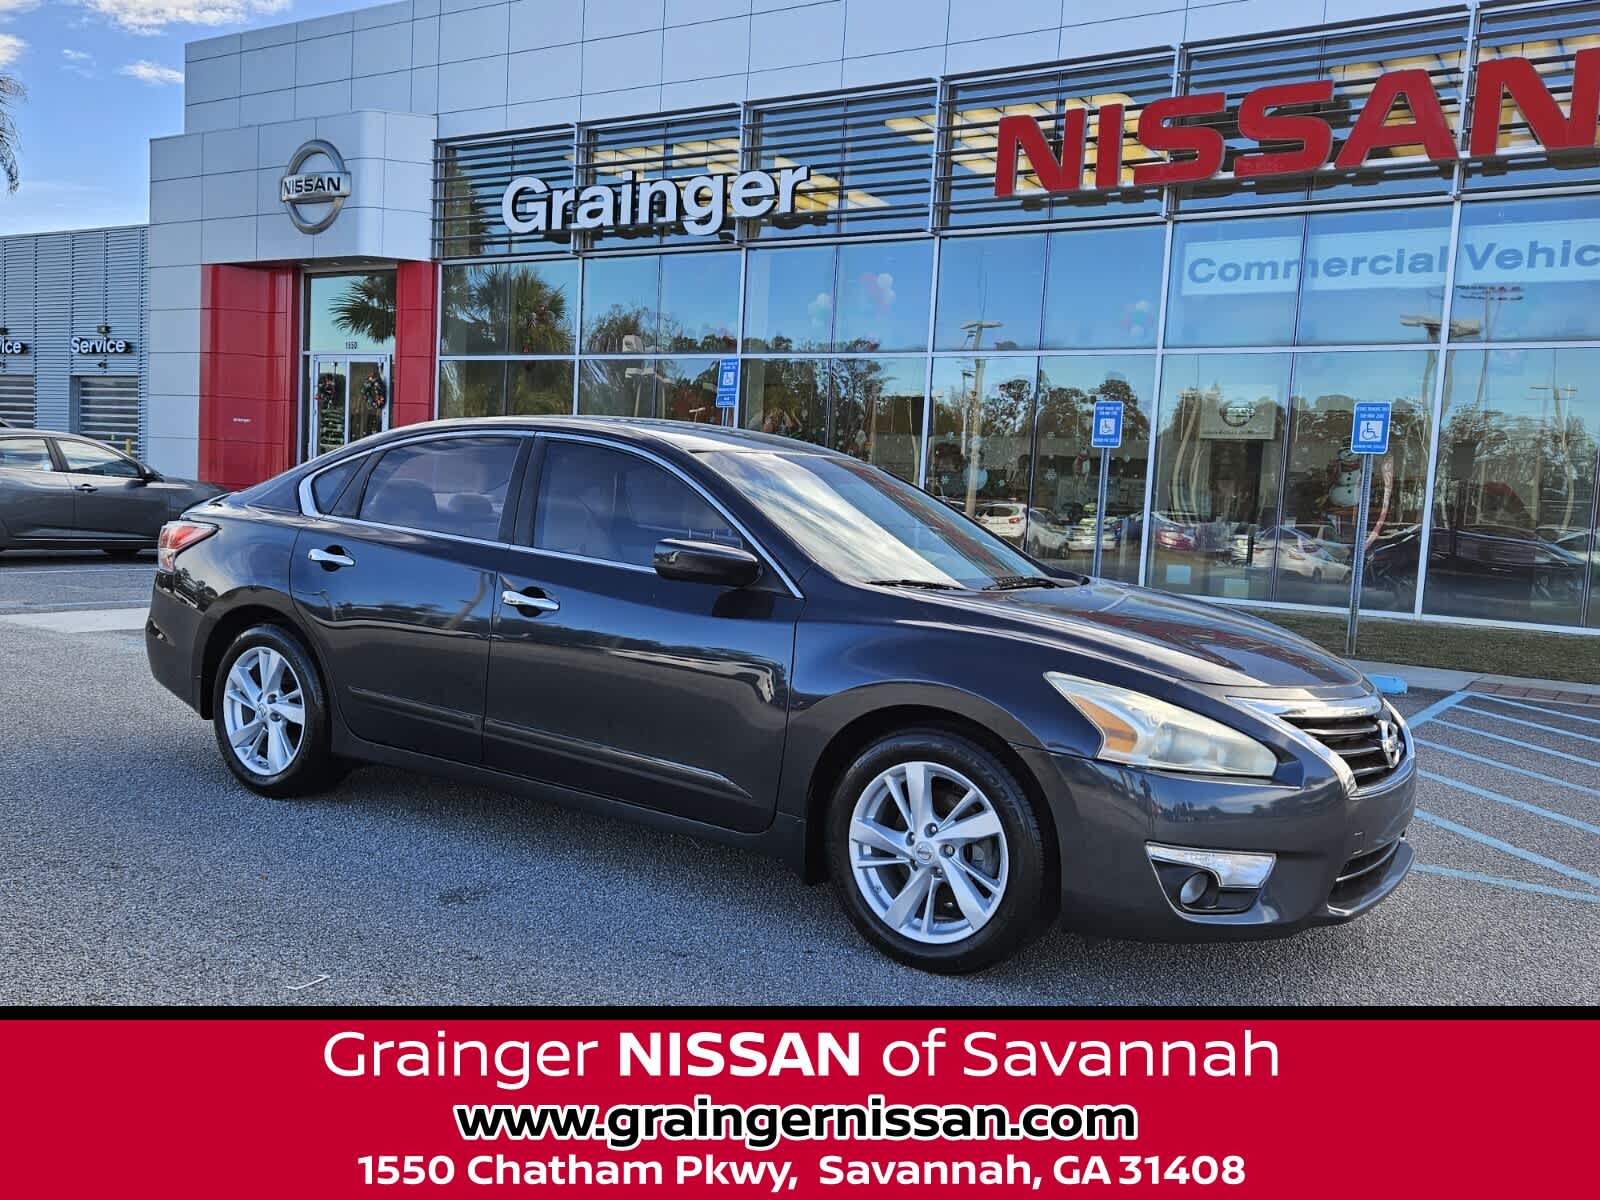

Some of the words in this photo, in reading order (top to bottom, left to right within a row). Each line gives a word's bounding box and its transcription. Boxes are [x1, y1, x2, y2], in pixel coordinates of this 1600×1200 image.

[994, 47, 1600, 196] NISSAN
[283, 176, 341, 195] NISSAN
[502, 165, 808, 235] Grainger
[1187, 245, 1450, 284] Commercial
[70, 336, 126, 354] Service
